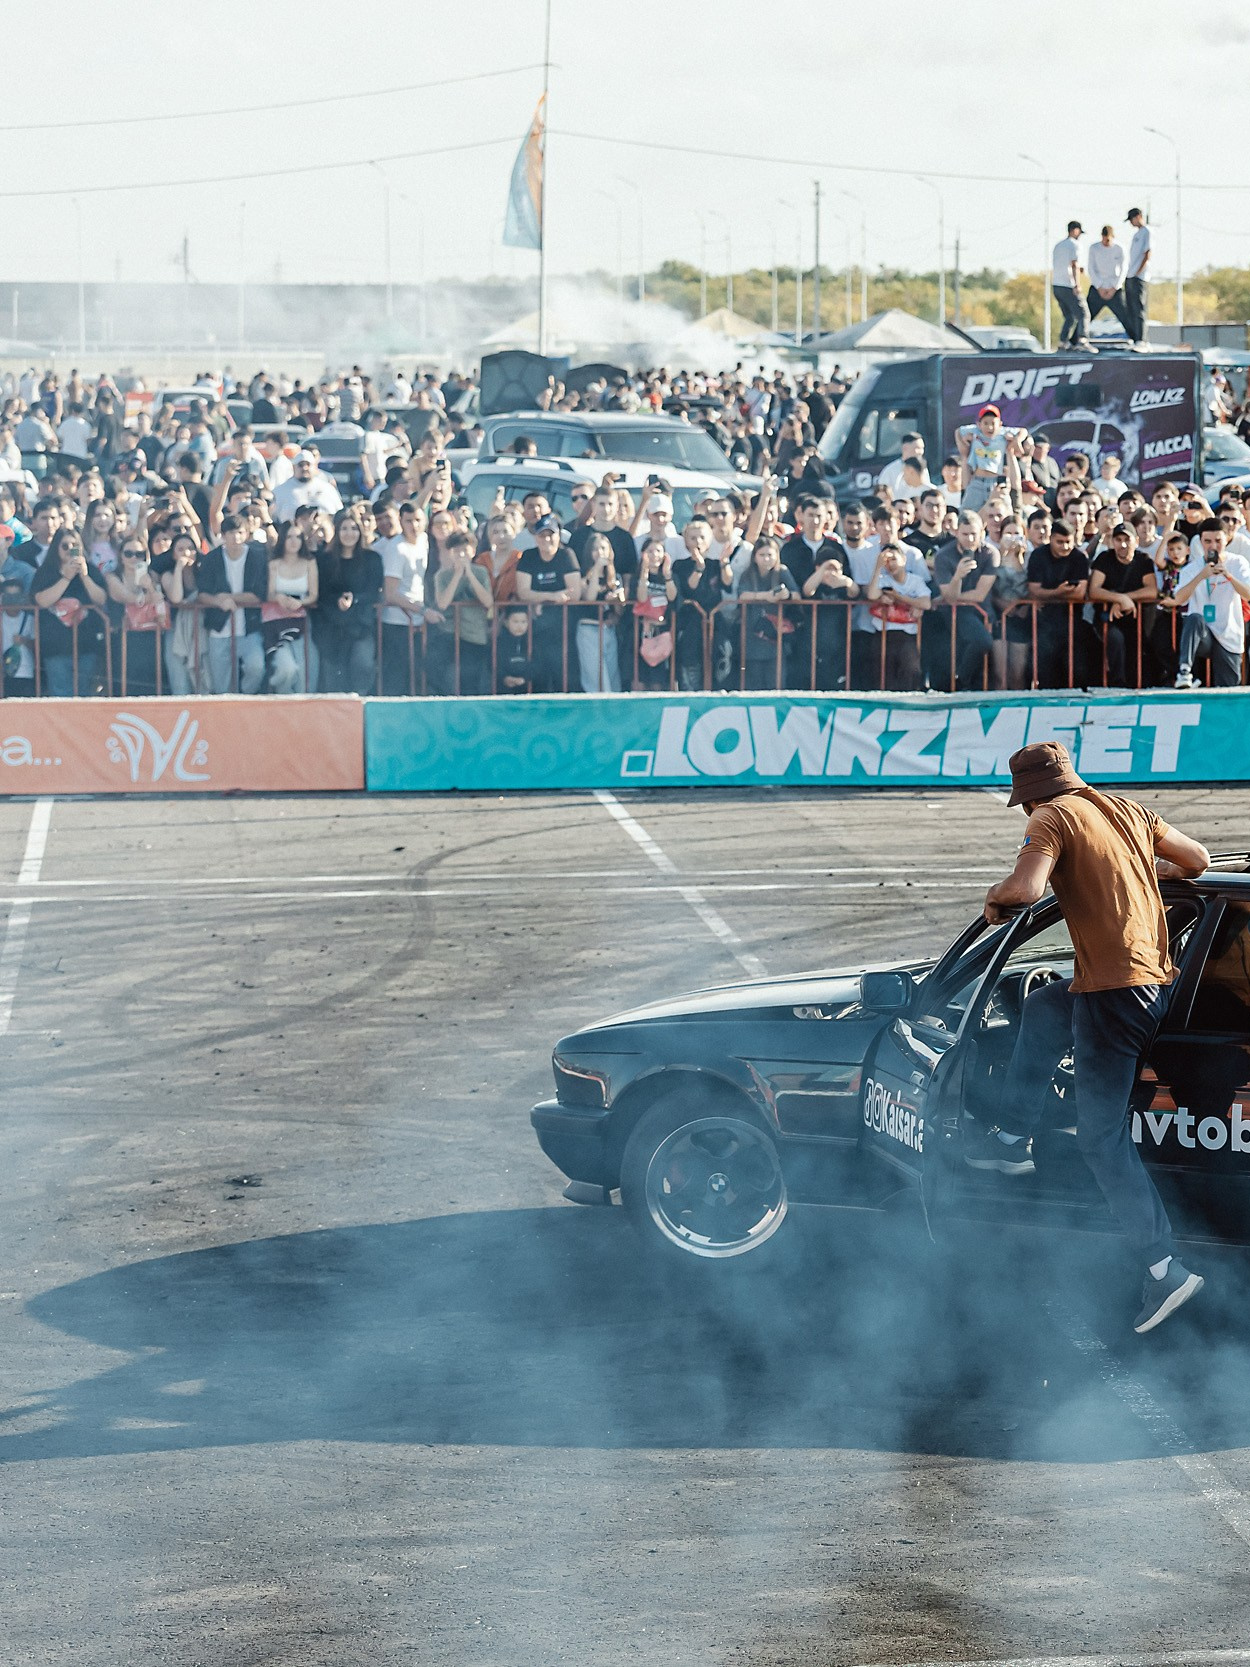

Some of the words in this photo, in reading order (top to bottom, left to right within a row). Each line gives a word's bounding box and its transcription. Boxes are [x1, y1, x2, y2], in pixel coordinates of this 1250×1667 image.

[960, 362, 1094, 407] DRIFT
[1129, 389, 1165, 407] LOW
[1143, 434, 1193, 460] КАССА
